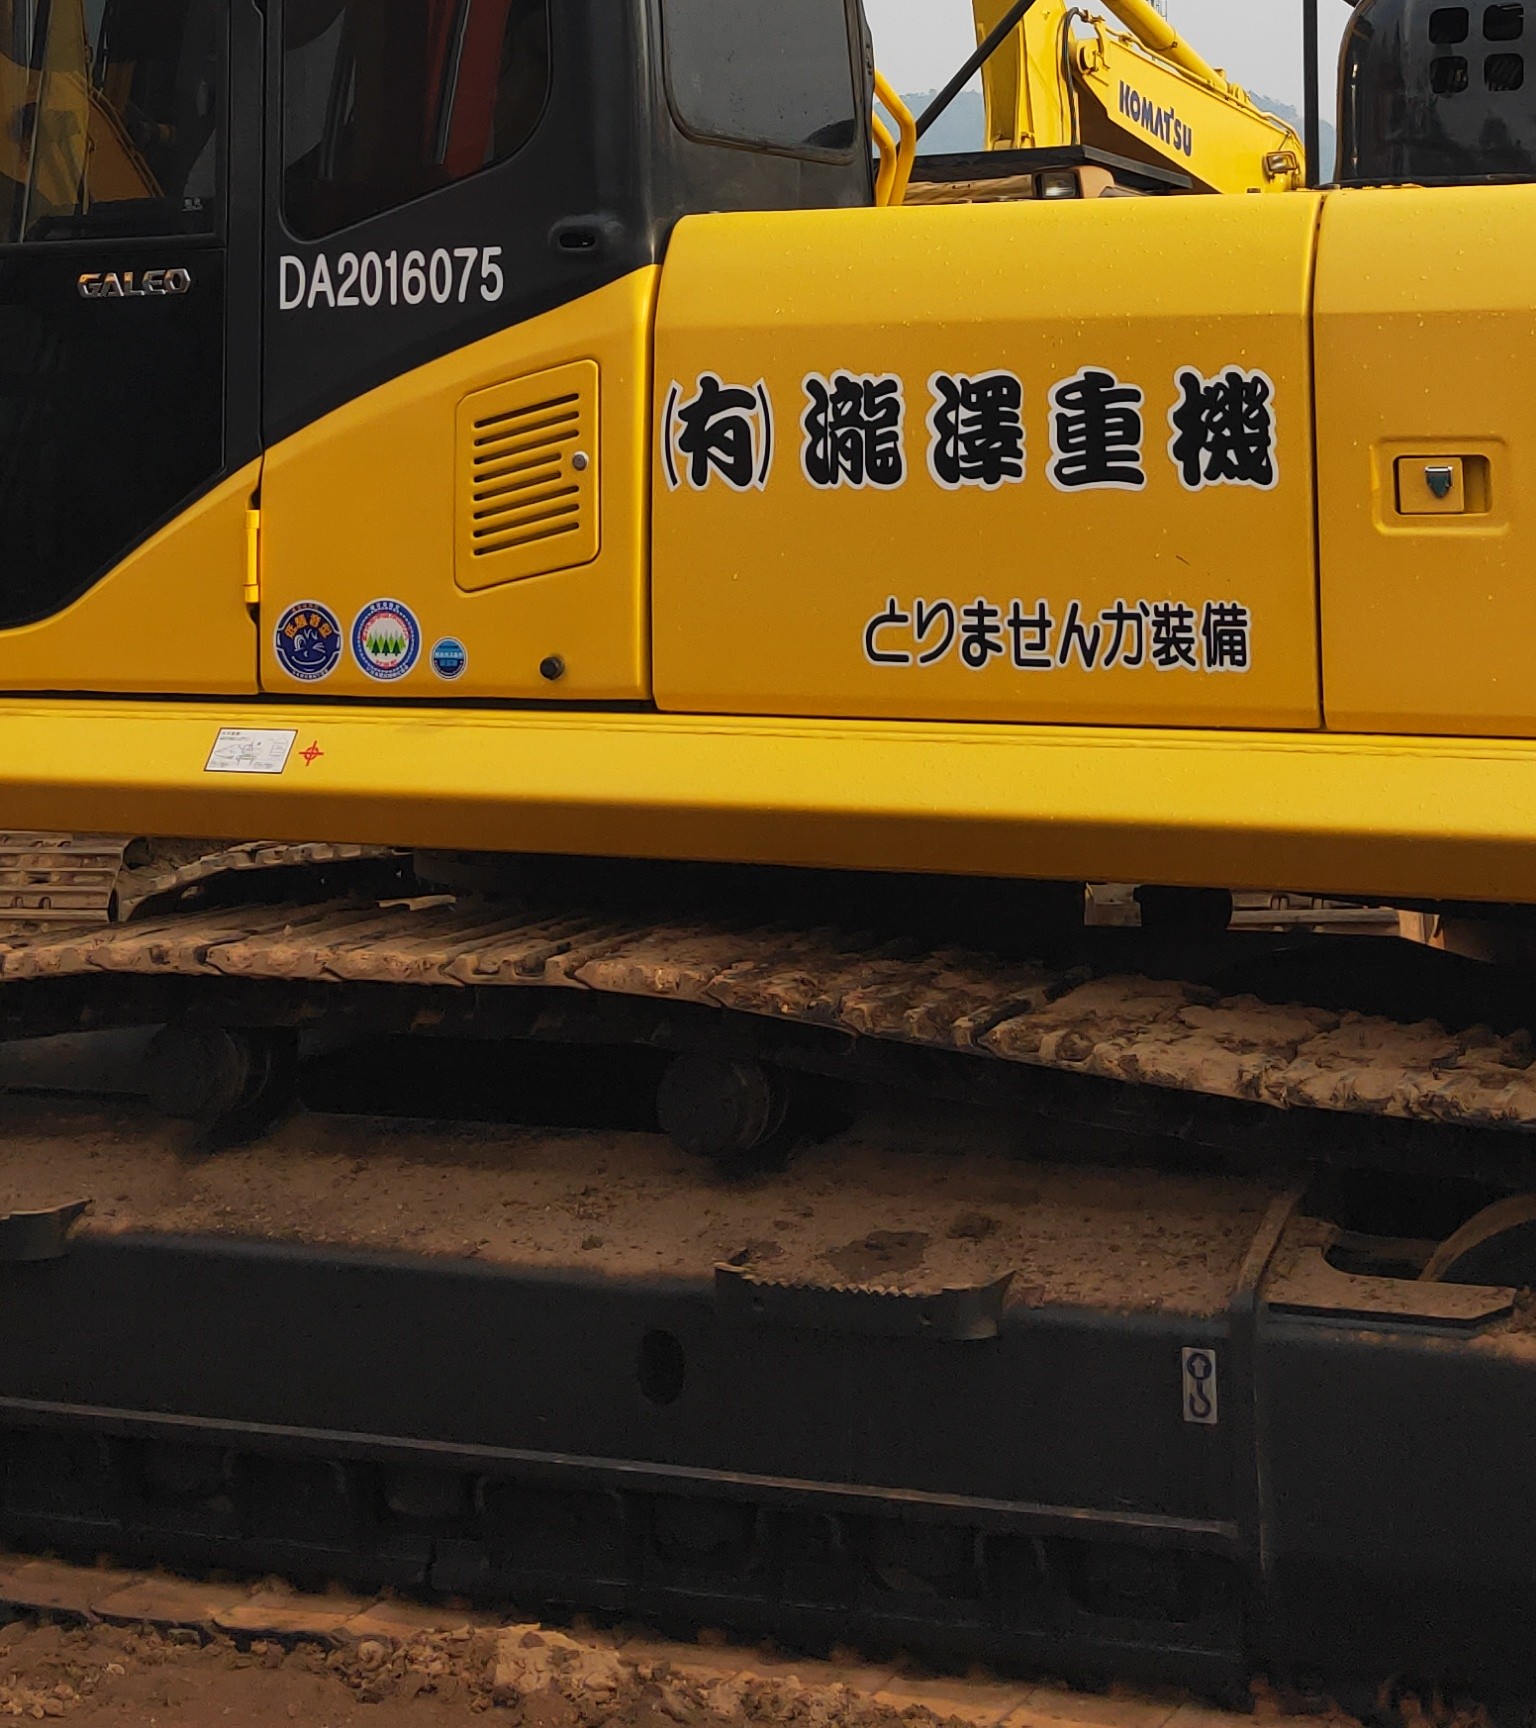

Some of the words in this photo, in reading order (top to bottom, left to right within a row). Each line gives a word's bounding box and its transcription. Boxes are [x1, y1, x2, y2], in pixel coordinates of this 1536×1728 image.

[1119, 79, 1192, 157] KOMATSU
[78, 268, 191, 298] GALEO
[279, 246, 505, 310] DA2016075
